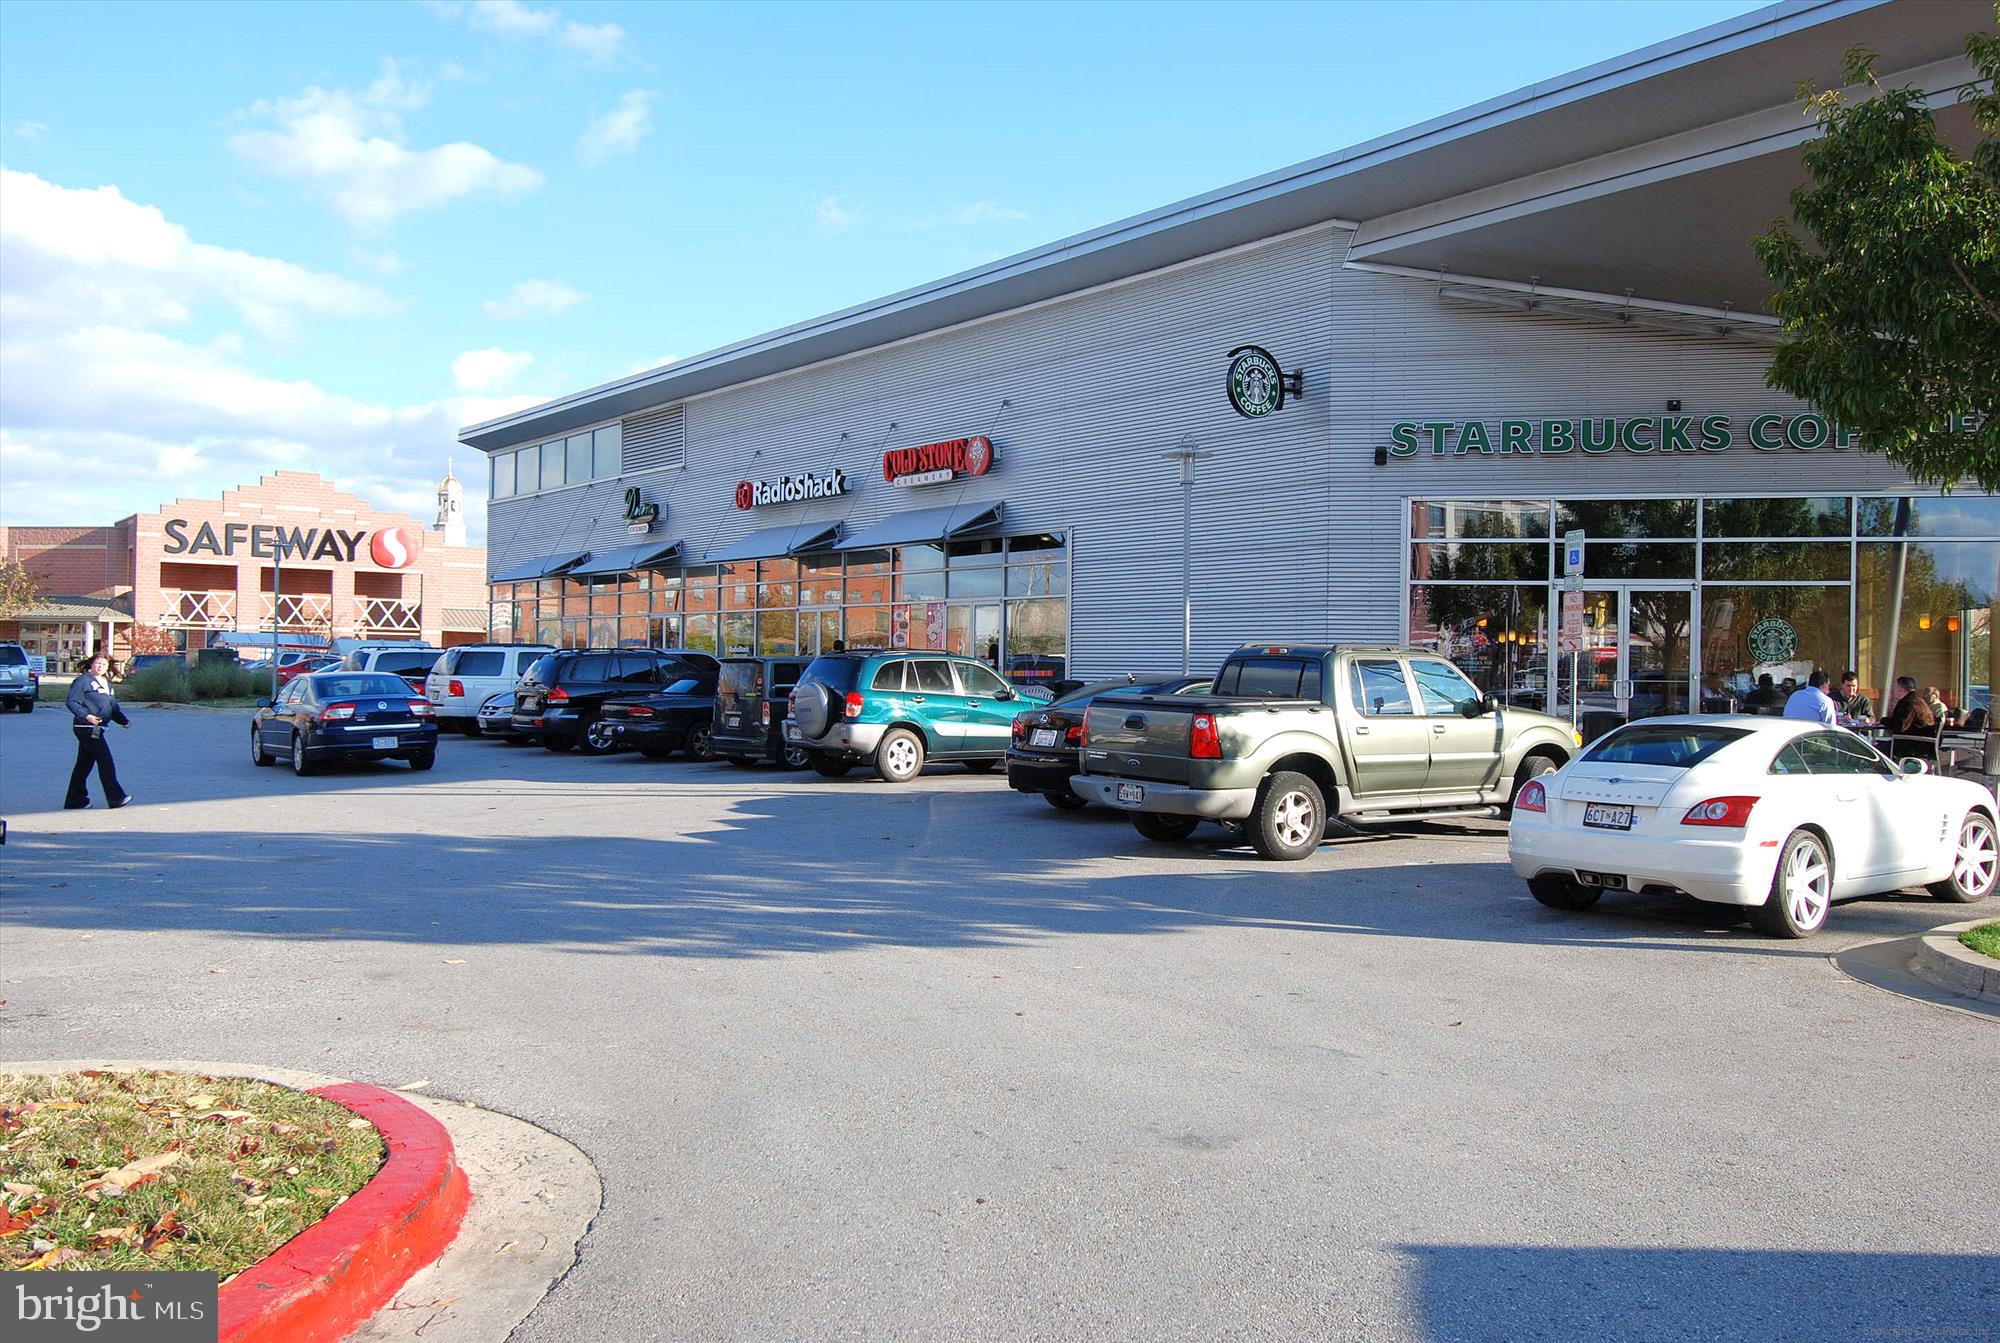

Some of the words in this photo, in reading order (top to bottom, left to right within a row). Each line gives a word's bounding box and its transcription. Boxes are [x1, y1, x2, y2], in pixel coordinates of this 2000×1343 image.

[1235, 356, 1277, 385] STARBUCKS
[1240, 396, 1272, 415] COFFEE
[1390, 415, 1733, 457] STARBUCKS
[883, 447, 918, 484] COLD
[919, 438, 968, 473] STONE
[752, 468, 842, 506] RadioShack
[895, 471, 951, 486] CREAMERY
[163, 518, 367, 563] SAFEWAY
[1612, 546, 1637, 556] 2500
[1750, 620, 1795, 640] STARBUCKS
[1755, 650, 1789, 661] COFFEE
[1587, 809, 1606, 821] 6CT
[1611, 811, 1630, 825] A27
